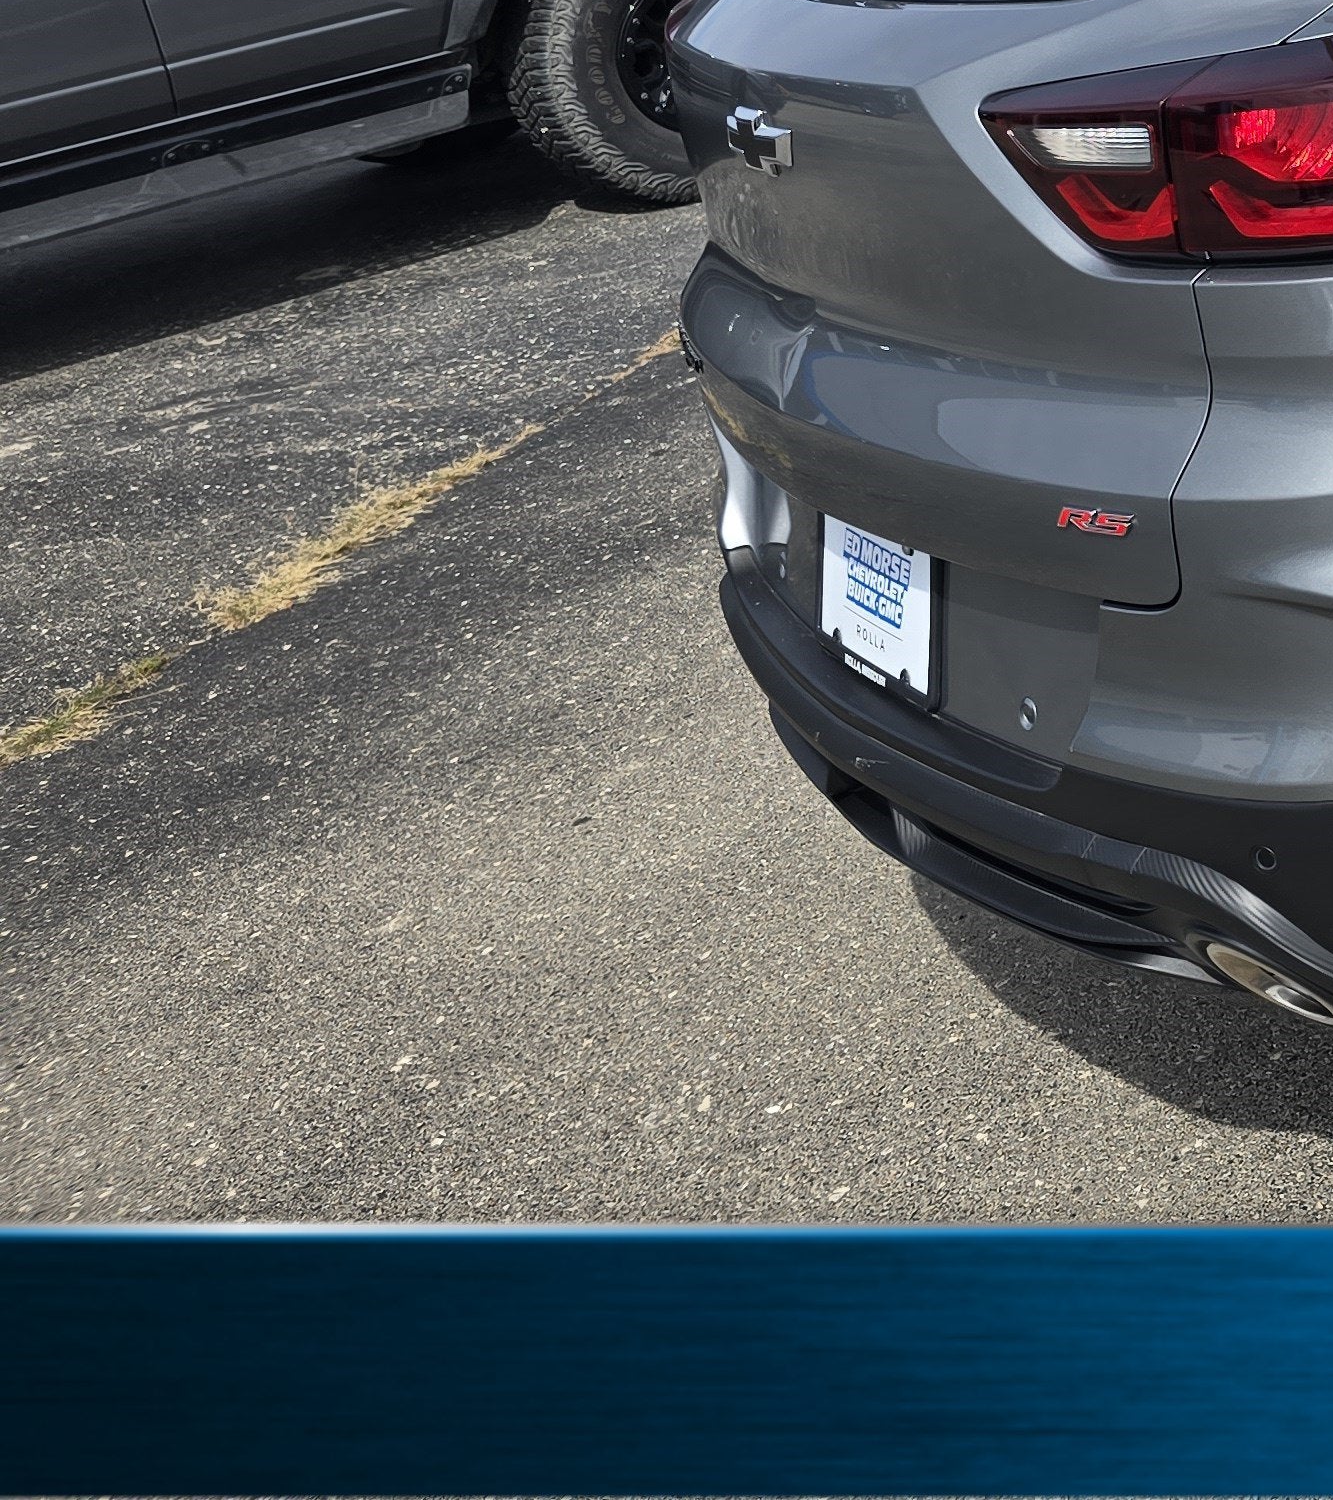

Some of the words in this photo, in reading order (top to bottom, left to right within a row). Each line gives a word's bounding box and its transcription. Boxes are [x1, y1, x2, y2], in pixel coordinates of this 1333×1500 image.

[1057, 506, 1135, 537] RS
[844, 528, 861, 559] ED
[861, 537, 912, 587] MORSE
[847, 556, 905, 604] CHEVROLET
[856, 623, 886, 652] ROLLA
